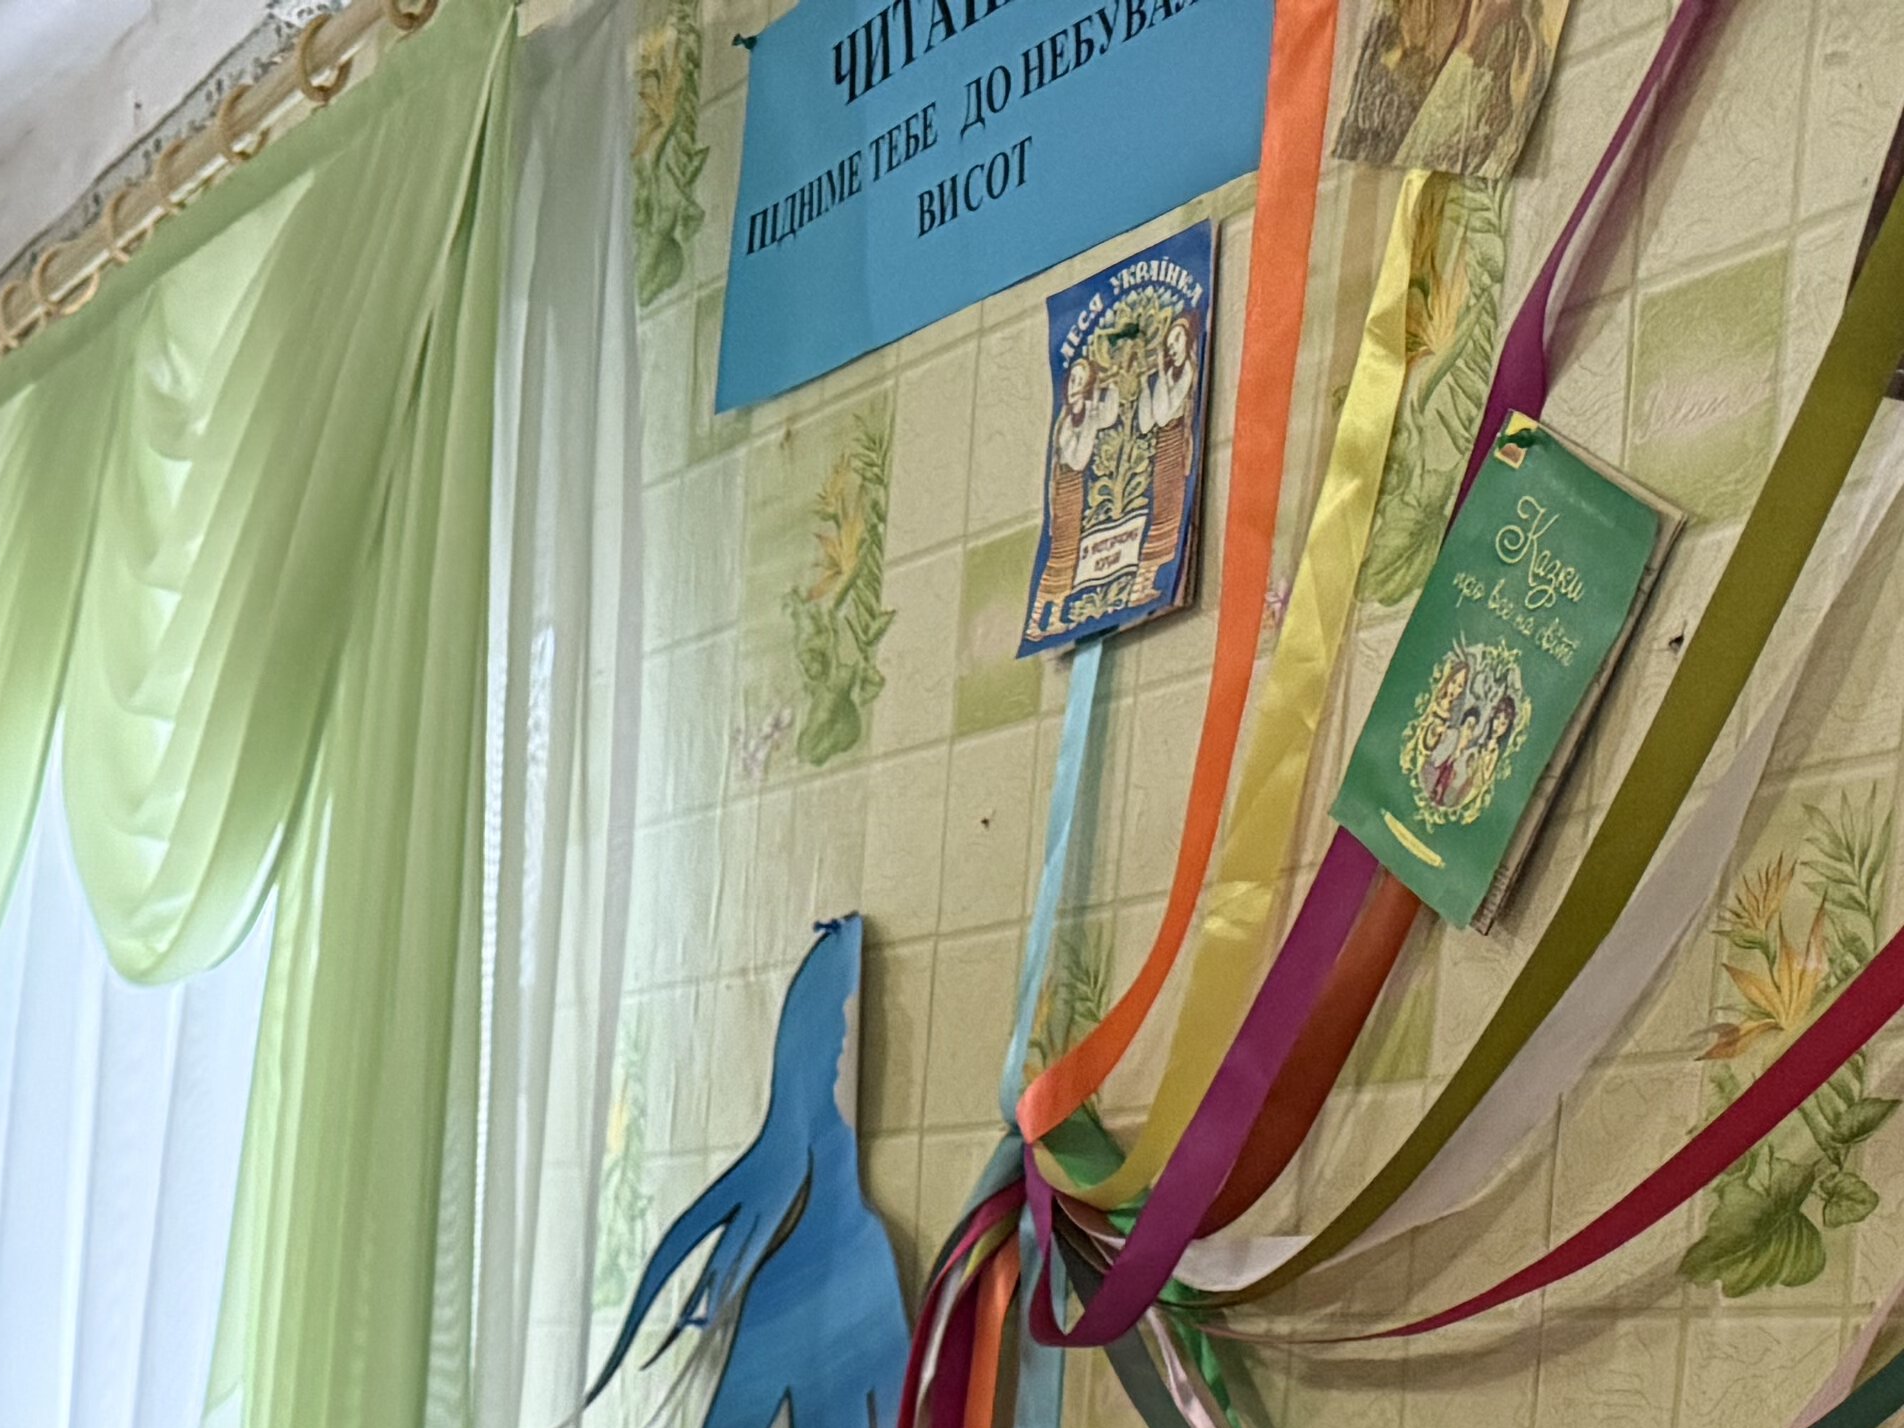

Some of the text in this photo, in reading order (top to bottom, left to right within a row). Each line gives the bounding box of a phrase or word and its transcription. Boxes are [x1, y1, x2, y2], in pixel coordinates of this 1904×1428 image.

[746, 0, 1198, 256] ПІДНІМЕ ТЕБЕ ДО НЕБУВА
[917, 136, 1033, 238] ВИСОТ
[1060, 256, 1203, 369] ЛЕСЯ УКРАЇНКА
[1495, 495, 1585, 610] Казки
